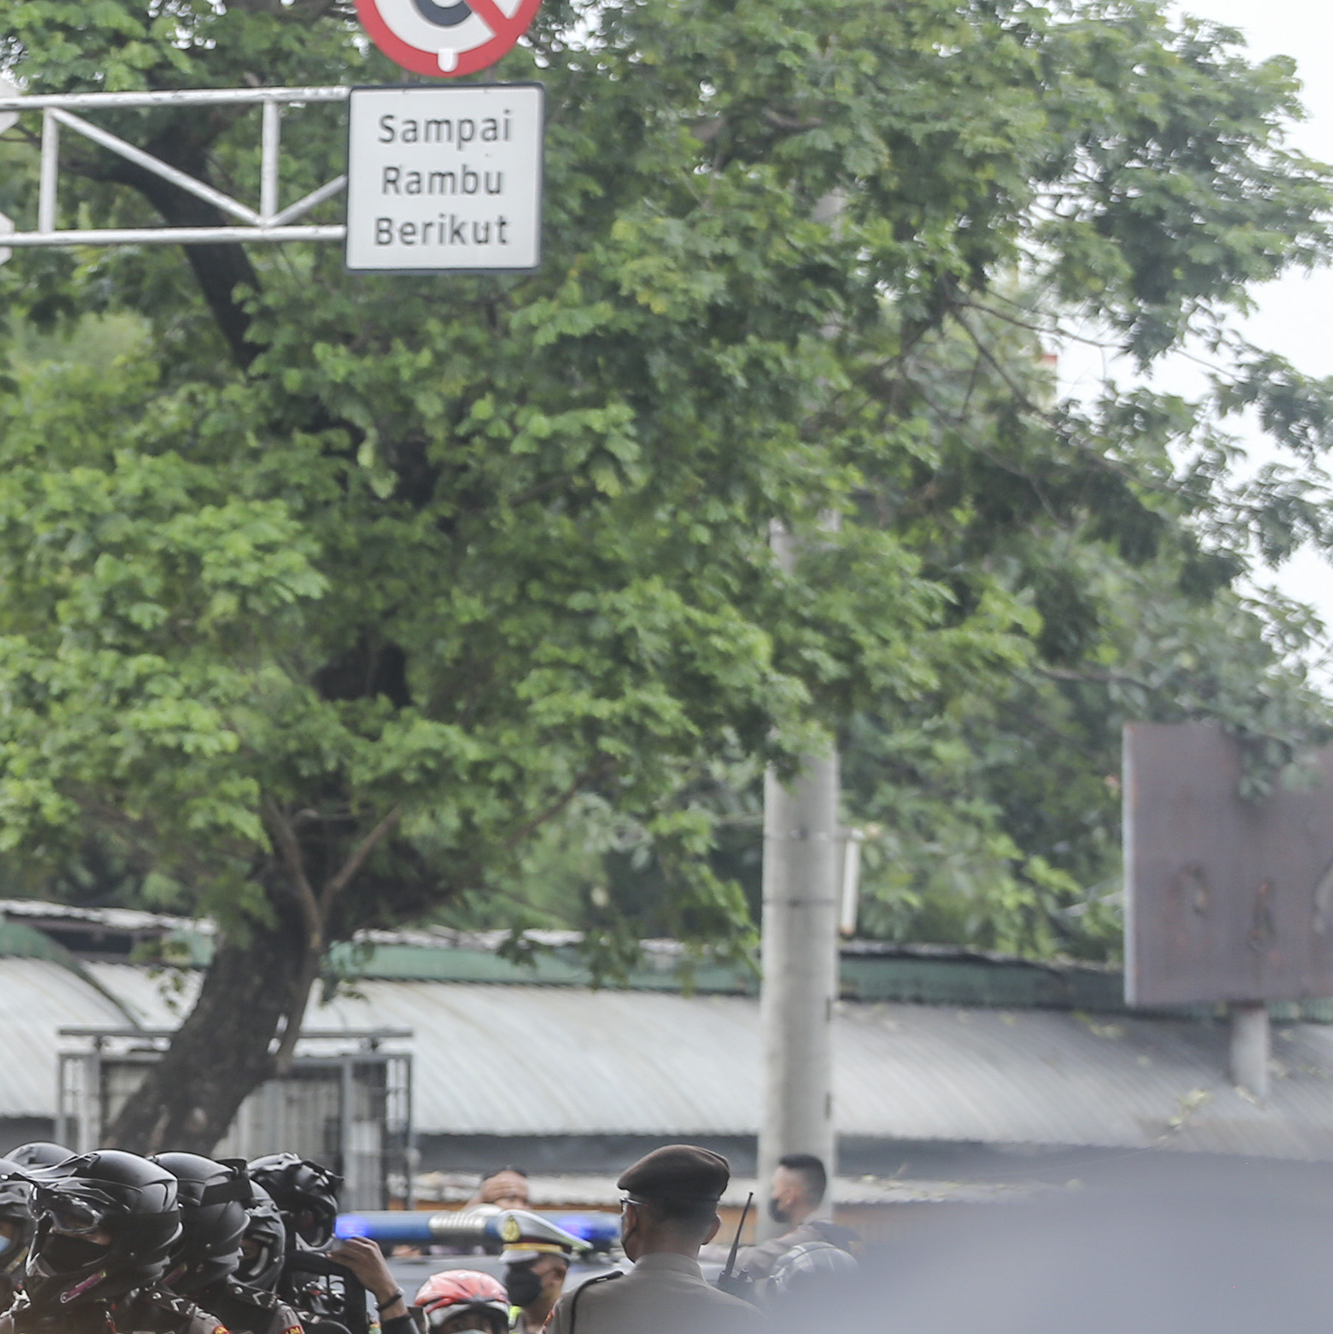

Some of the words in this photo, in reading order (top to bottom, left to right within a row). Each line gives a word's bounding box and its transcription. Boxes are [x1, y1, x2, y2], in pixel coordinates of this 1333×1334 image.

[378, 109, 513, 151] Sampai
[382, 164, 502, 195] Rambu
[374, 213, 510, 247] Berikut
